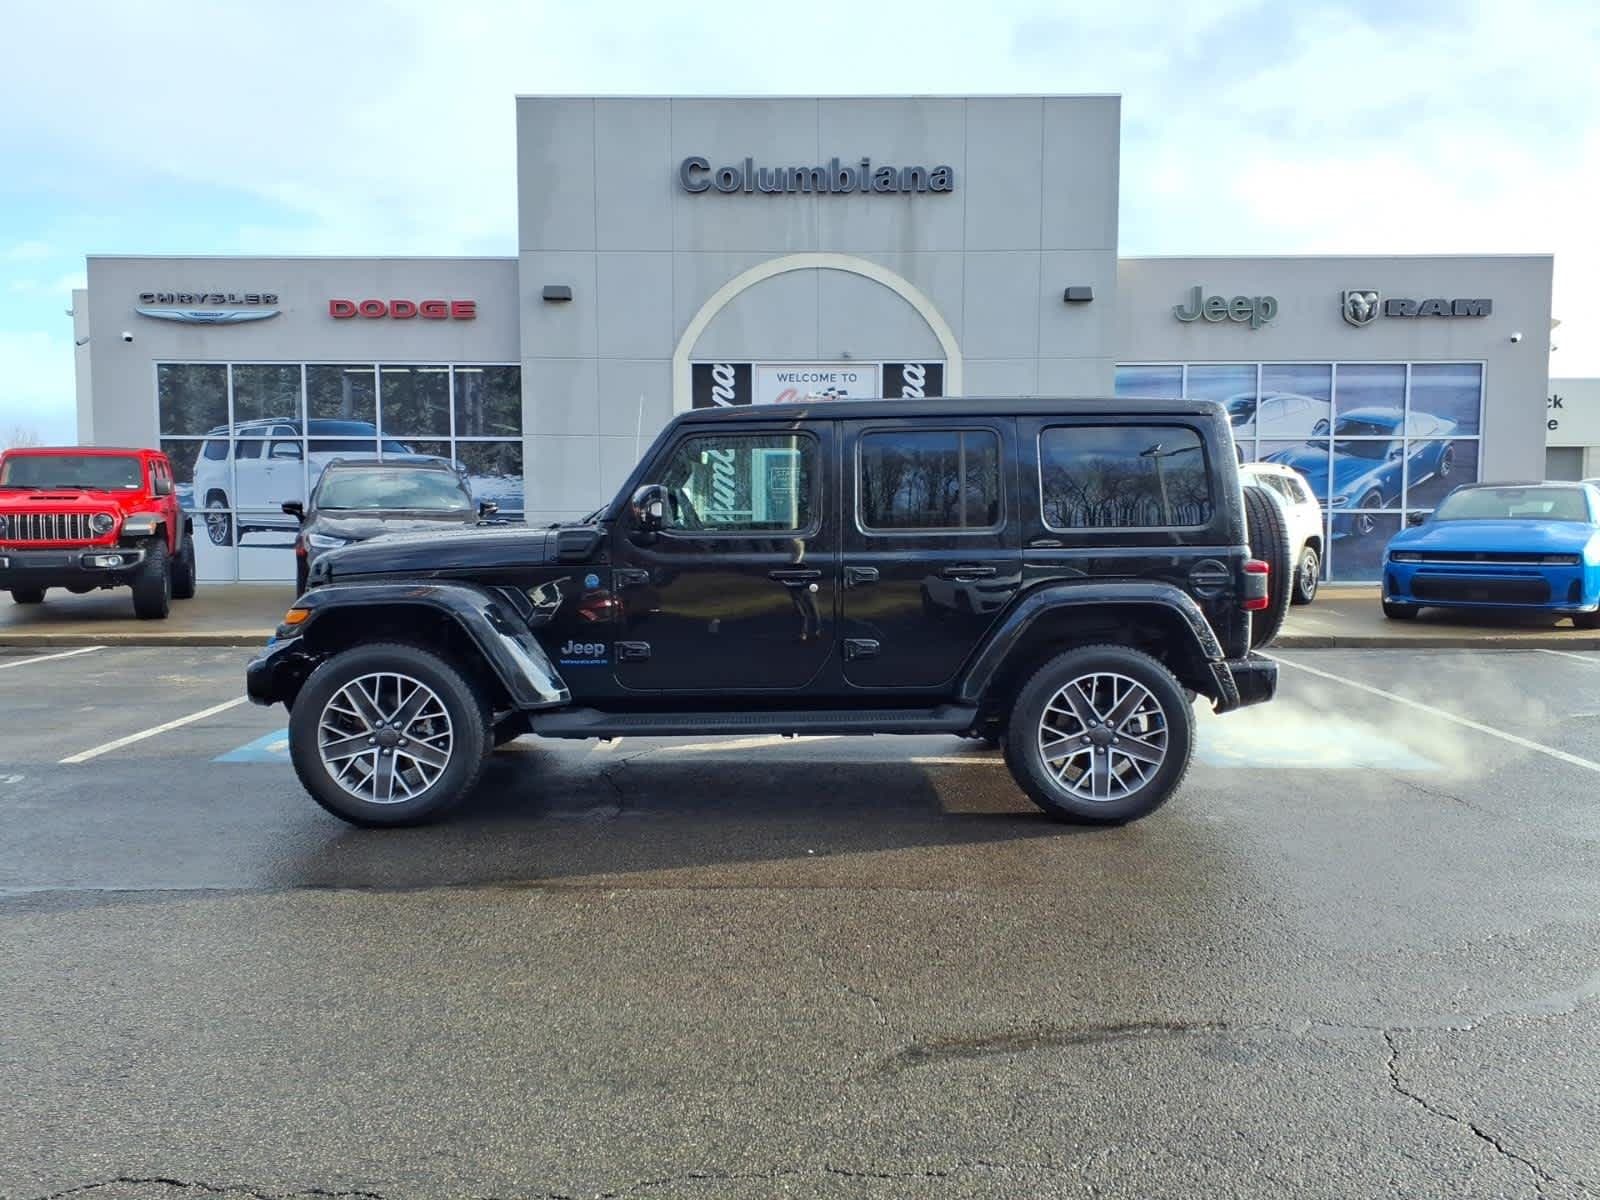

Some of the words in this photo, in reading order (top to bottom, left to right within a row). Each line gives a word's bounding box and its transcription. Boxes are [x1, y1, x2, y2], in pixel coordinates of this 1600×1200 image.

[679, 156, 954, 193] Columbiana
[138, 293, 280, 305] CHRYSLER
[1174, 286, 1278, 329] Jeep
[1385, 299, 1493, 316] RAM
[329, 299, 477, 319] DODGE
[777, 373, 837, 383] WELCOME
[841, 373, 858, 383] TO
[561, 640, 606, 657] Jeep
